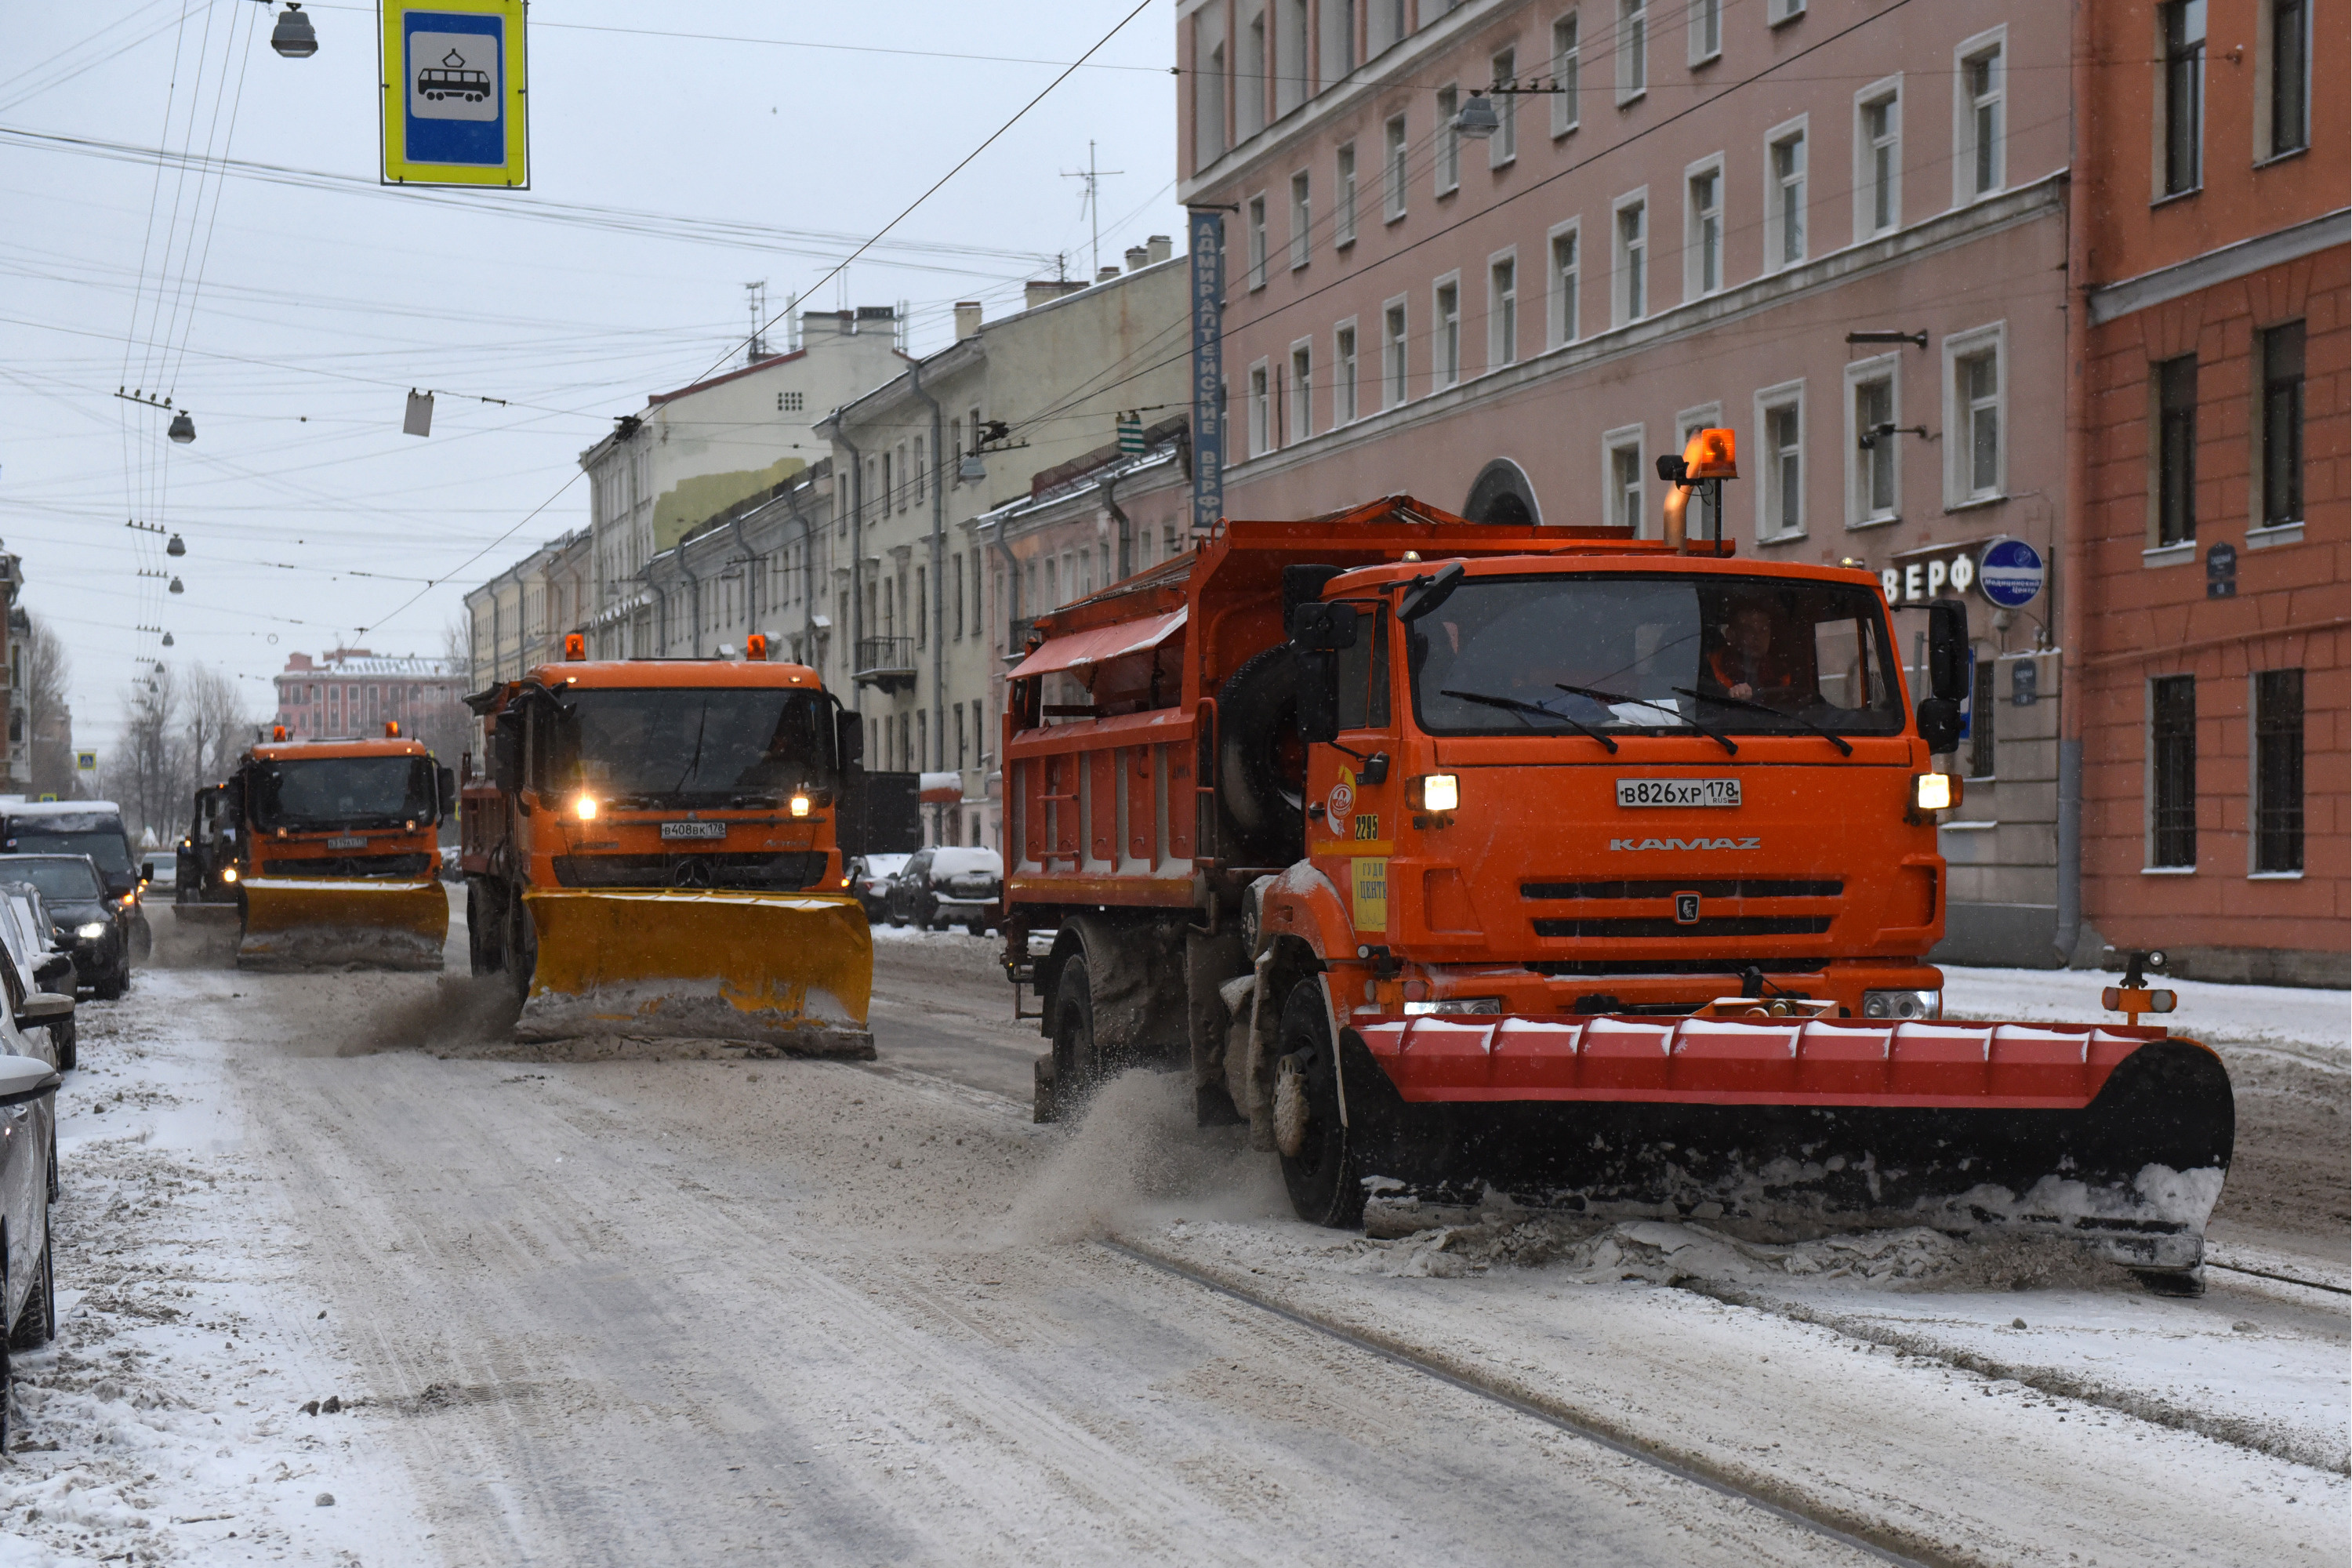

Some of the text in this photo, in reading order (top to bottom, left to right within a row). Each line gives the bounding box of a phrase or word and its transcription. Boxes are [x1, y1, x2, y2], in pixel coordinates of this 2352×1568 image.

[1196, 222, 1221, 524] АДМИРАЛТЕЙСКИЕ ВЕРФИ
[1984, 578, 2040, 588] Медицинский
[2011, 586, 2037, 595] Центр
[1624, 781, 1735, 804] В826ХР 178
[1355, 815, 1378, 840] 2295
[1610, 837, 1762, 851] KAMAZ
[1362, 862, 1384, 879] ГУДП
